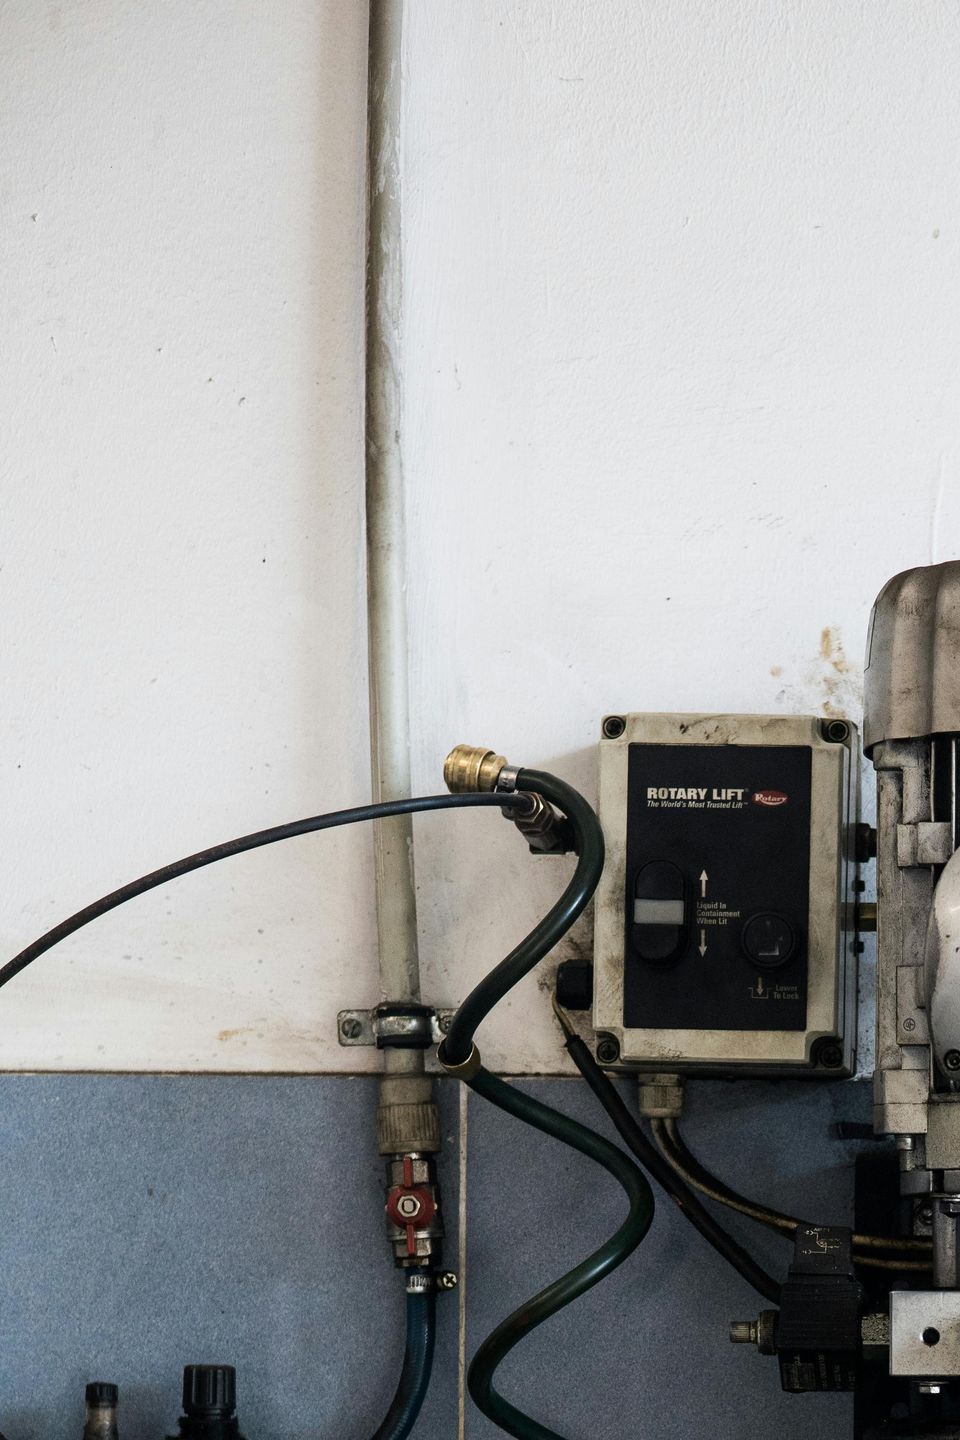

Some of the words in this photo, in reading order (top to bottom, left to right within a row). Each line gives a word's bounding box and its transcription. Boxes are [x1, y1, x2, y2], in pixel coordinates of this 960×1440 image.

[647, 787, 707, 800] ROTARY
[647, 800, 659, 808] The
[660, 800, 687, 808] World's
[706, 801, 731, 809] Trusted
[754, 793, 788, 806] Rotary
[697, 902, 718, 910] Liquid
